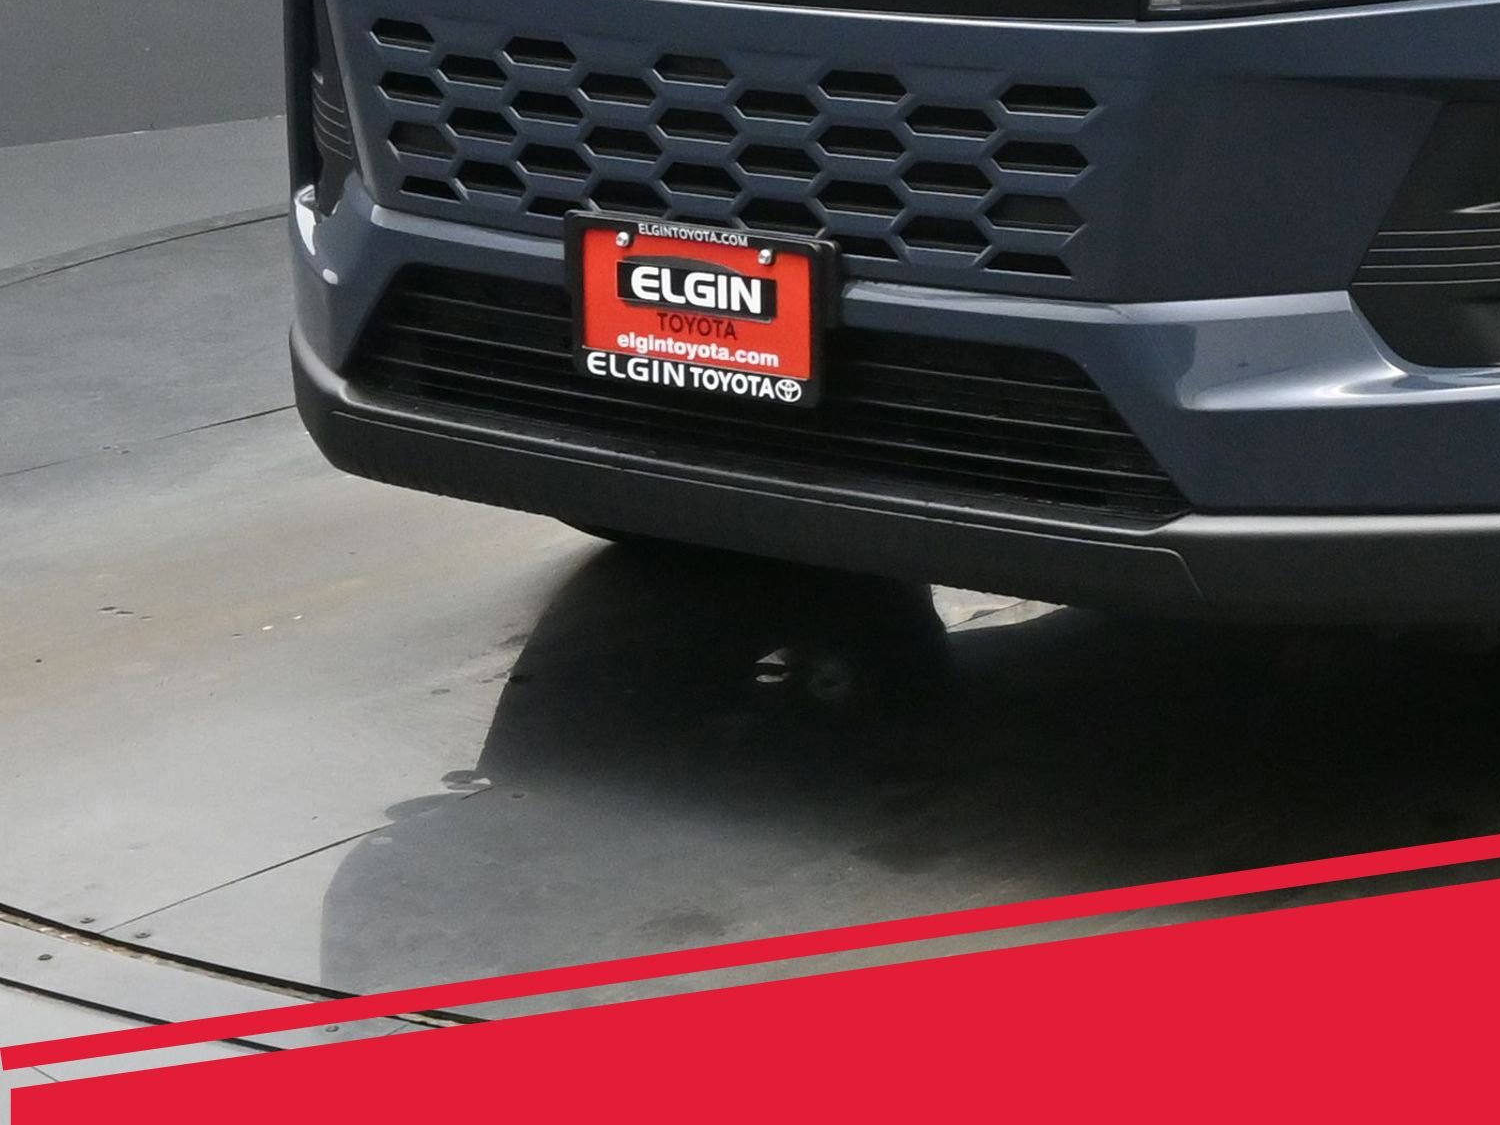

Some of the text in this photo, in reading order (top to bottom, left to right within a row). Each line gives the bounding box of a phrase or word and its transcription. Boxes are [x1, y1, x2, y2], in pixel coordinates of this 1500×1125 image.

[638, 223, 748, 247] ELGINTOYOTA.COM
[631, 266, 762, 313] ELGIN
[656, 312, 737, 339] TOYOTA
[617, 332, 779, 368] elgintoyota.com
[587, 352, 775, 399] ELGIN TOYOTA
